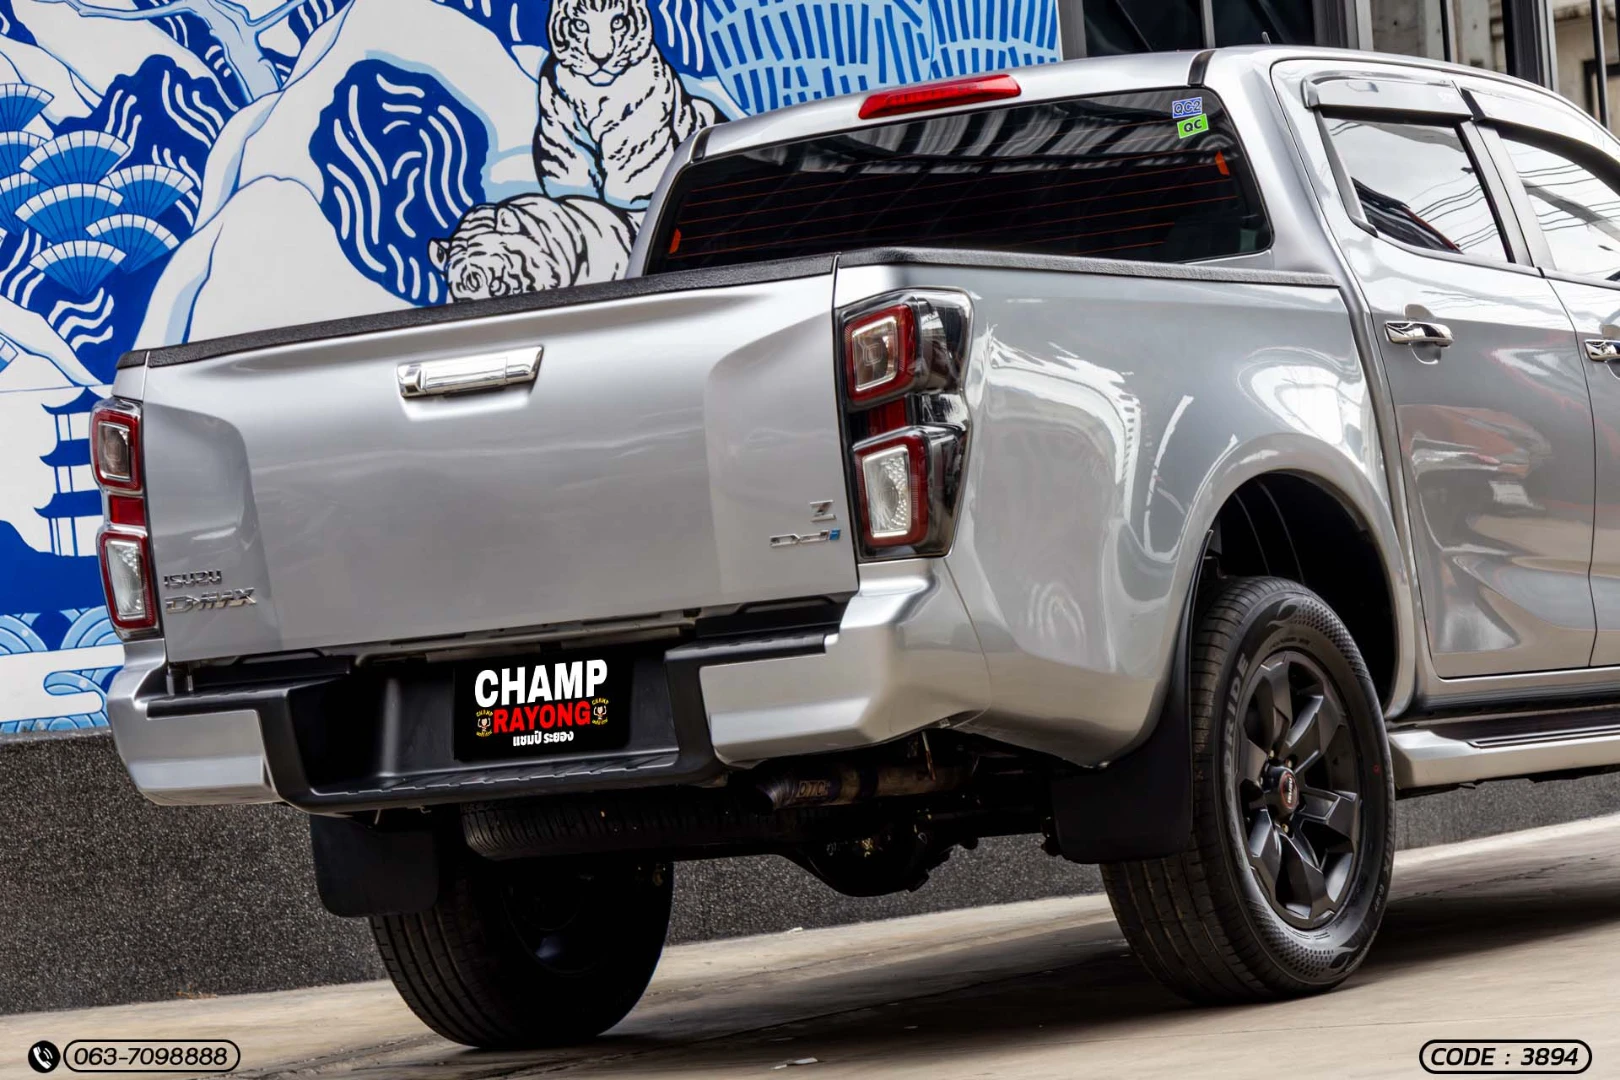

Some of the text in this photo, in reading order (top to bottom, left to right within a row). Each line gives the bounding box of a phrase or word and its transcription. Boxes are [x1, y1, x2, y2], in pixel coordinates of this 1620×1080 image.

[1174, 101, 1201, 115] QC2
[1184, 119, 1202, 132] QC
[163, 569, 222, 588] ISUZU
